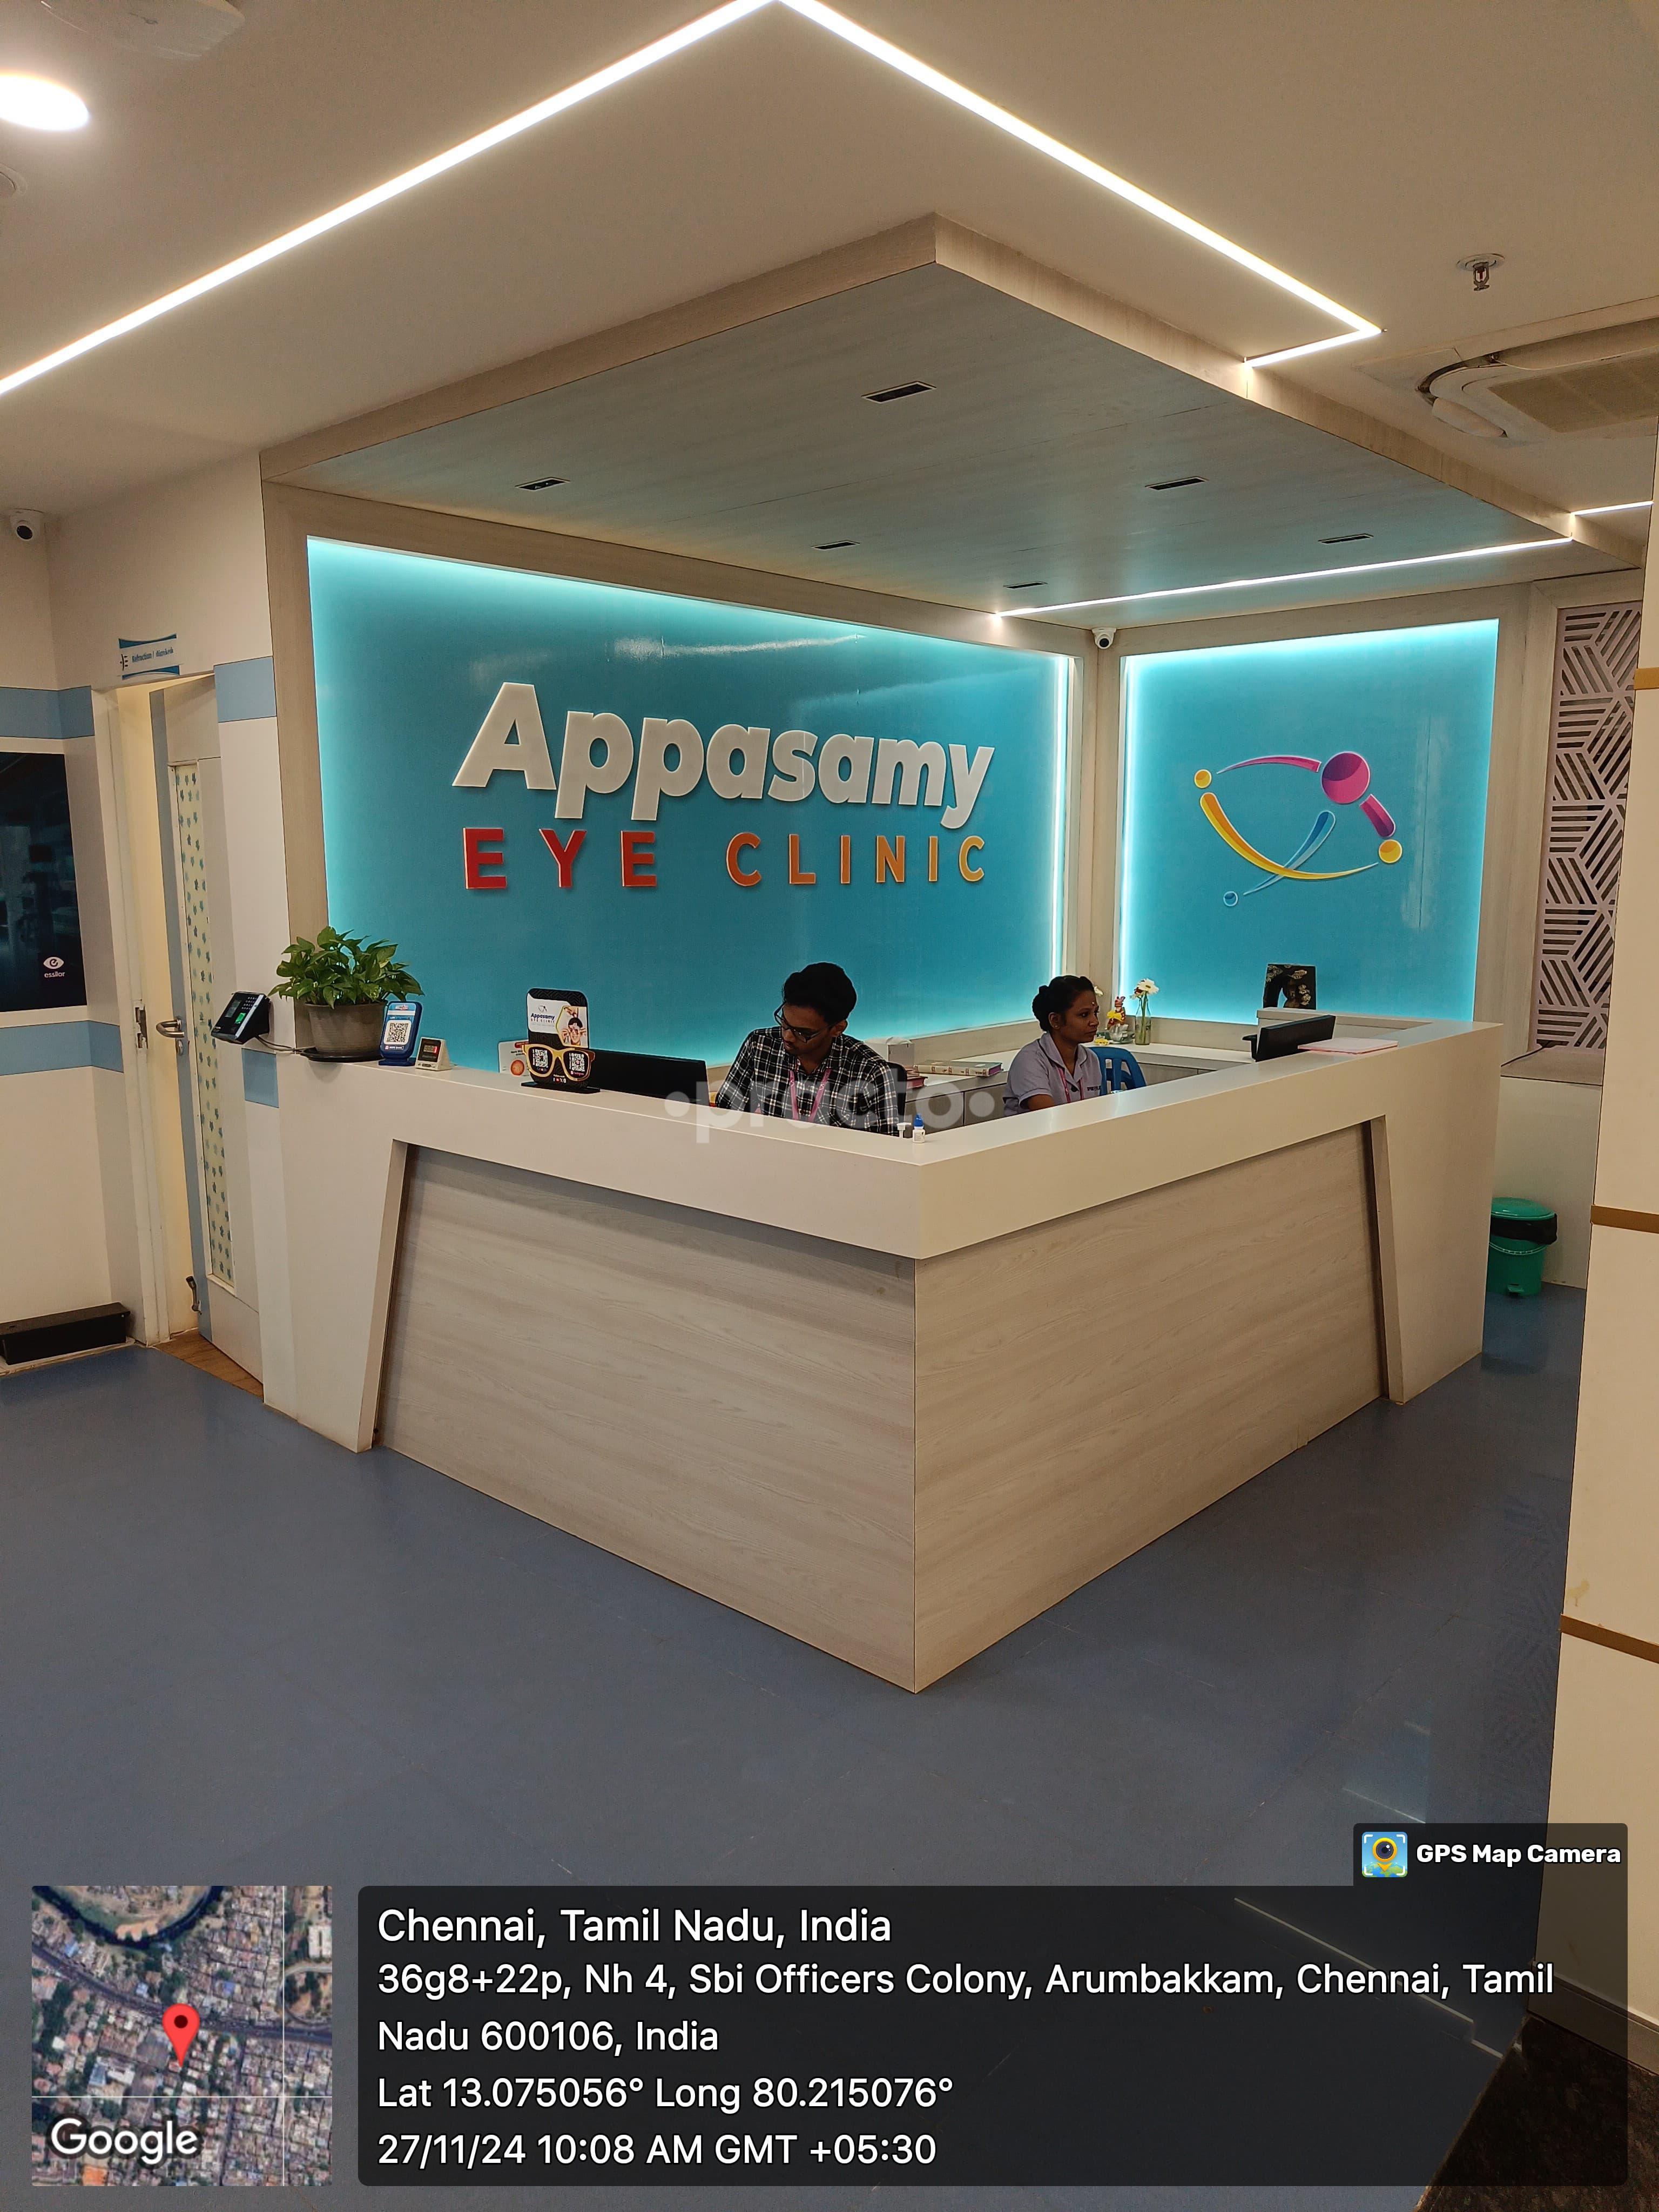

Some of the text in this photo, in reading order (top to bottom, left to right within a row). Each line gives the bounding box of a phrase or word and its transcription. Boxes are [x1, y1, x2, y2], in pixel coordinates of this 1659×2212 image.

[451, 682, 995, 829] Appasamy
[463, 827, 985, 889] EYE CLINIC
[531, 1013, 555, 1021] Appasamy
